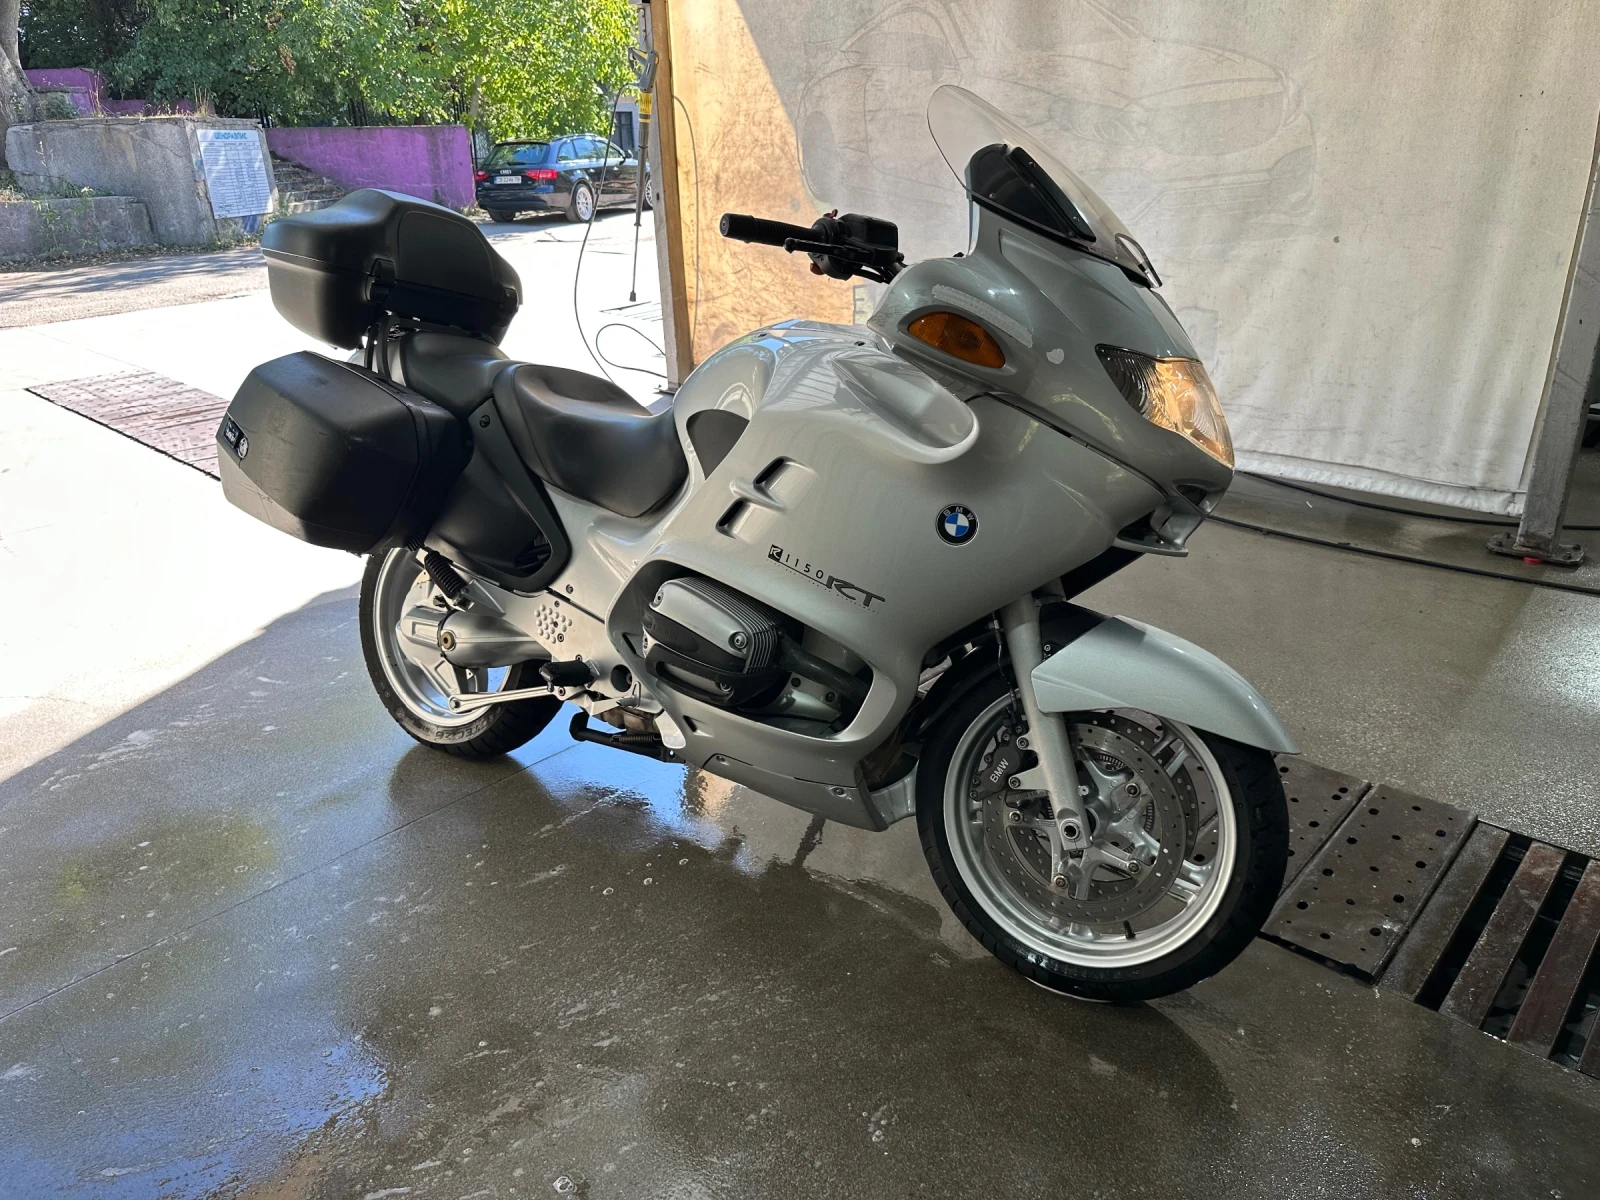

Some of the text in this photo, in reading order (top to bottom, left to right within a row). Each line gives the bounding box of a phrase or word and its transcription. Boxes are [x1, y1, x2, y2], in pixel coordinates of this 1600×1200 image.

[213, 131, 248, 140] ЦЕНОРАЗПИС
[943, 506, 975, 520] BMW
[989, 758, 1009, 783] BMW
